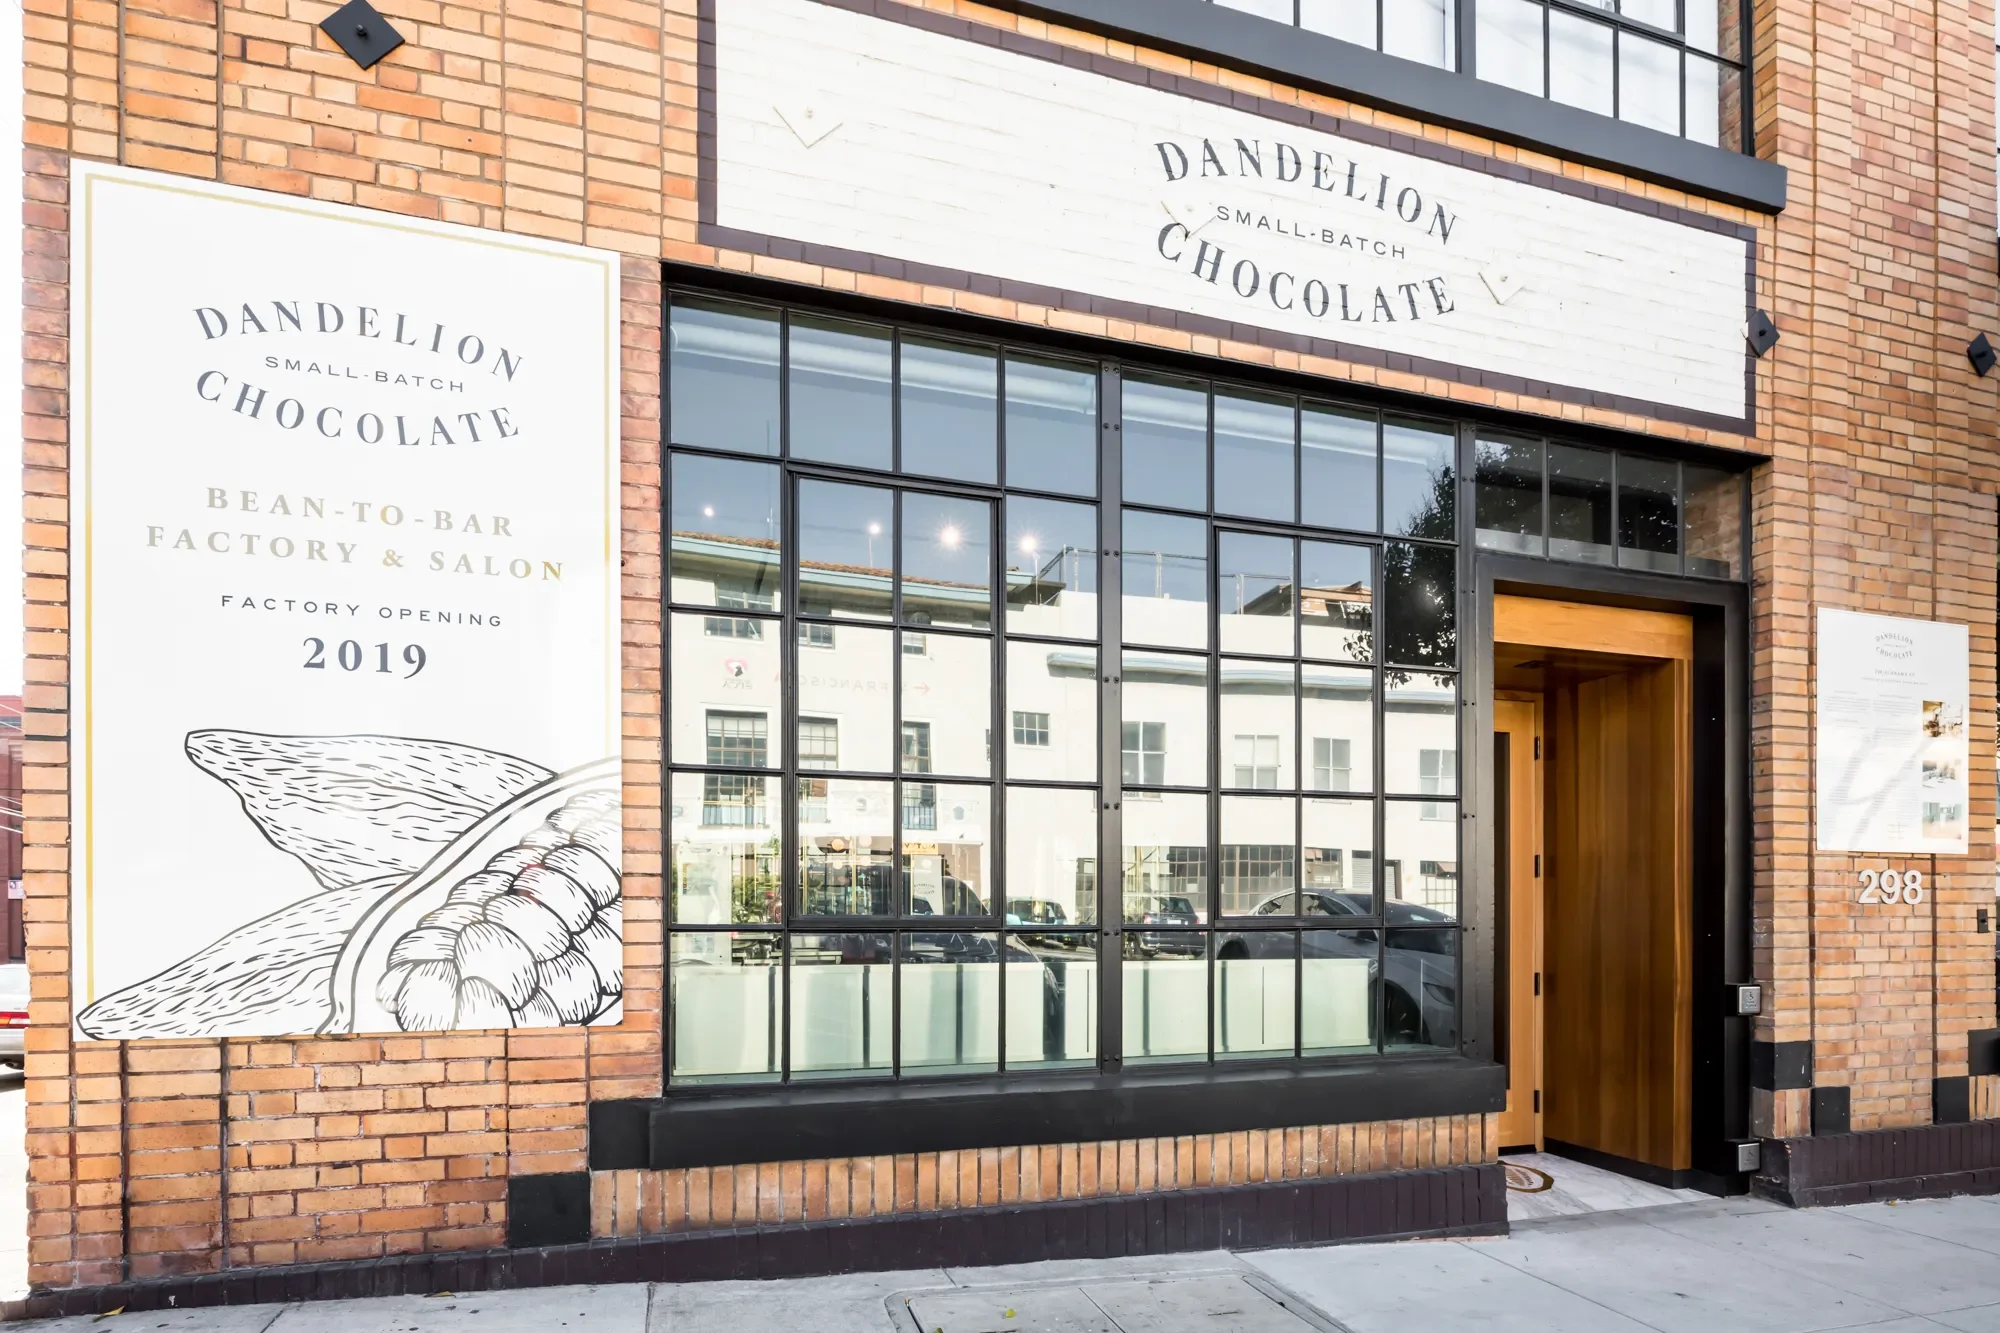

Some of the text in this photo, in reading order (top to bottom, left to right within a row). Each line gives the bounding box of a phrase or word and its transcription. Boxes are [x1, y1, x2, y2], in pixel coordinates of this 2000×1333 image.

[1154, 137, 1457, 246] DANDELION
[1216, 205, 1405, 259] SMALL-BATCH
[1157, 222, 1455, 323] CHOCOLATE
[193, 301, 523, 382] DANDELION
[265, 356, 464, 393] SMALL-BATCH
[196, 370, 519, 446] CHOCOLATE
[206, 487, 513, 537] BEAN-TO-BAR
[146, 525, 563, 581] FACTORY & SALON
[221, 594, 501, 627] FACTORY OPENING
[302, 637, 427, 680] 2019
[1875, 632, 1914, 645] DANDELION
[1857, 869, 1923, 905] 298
